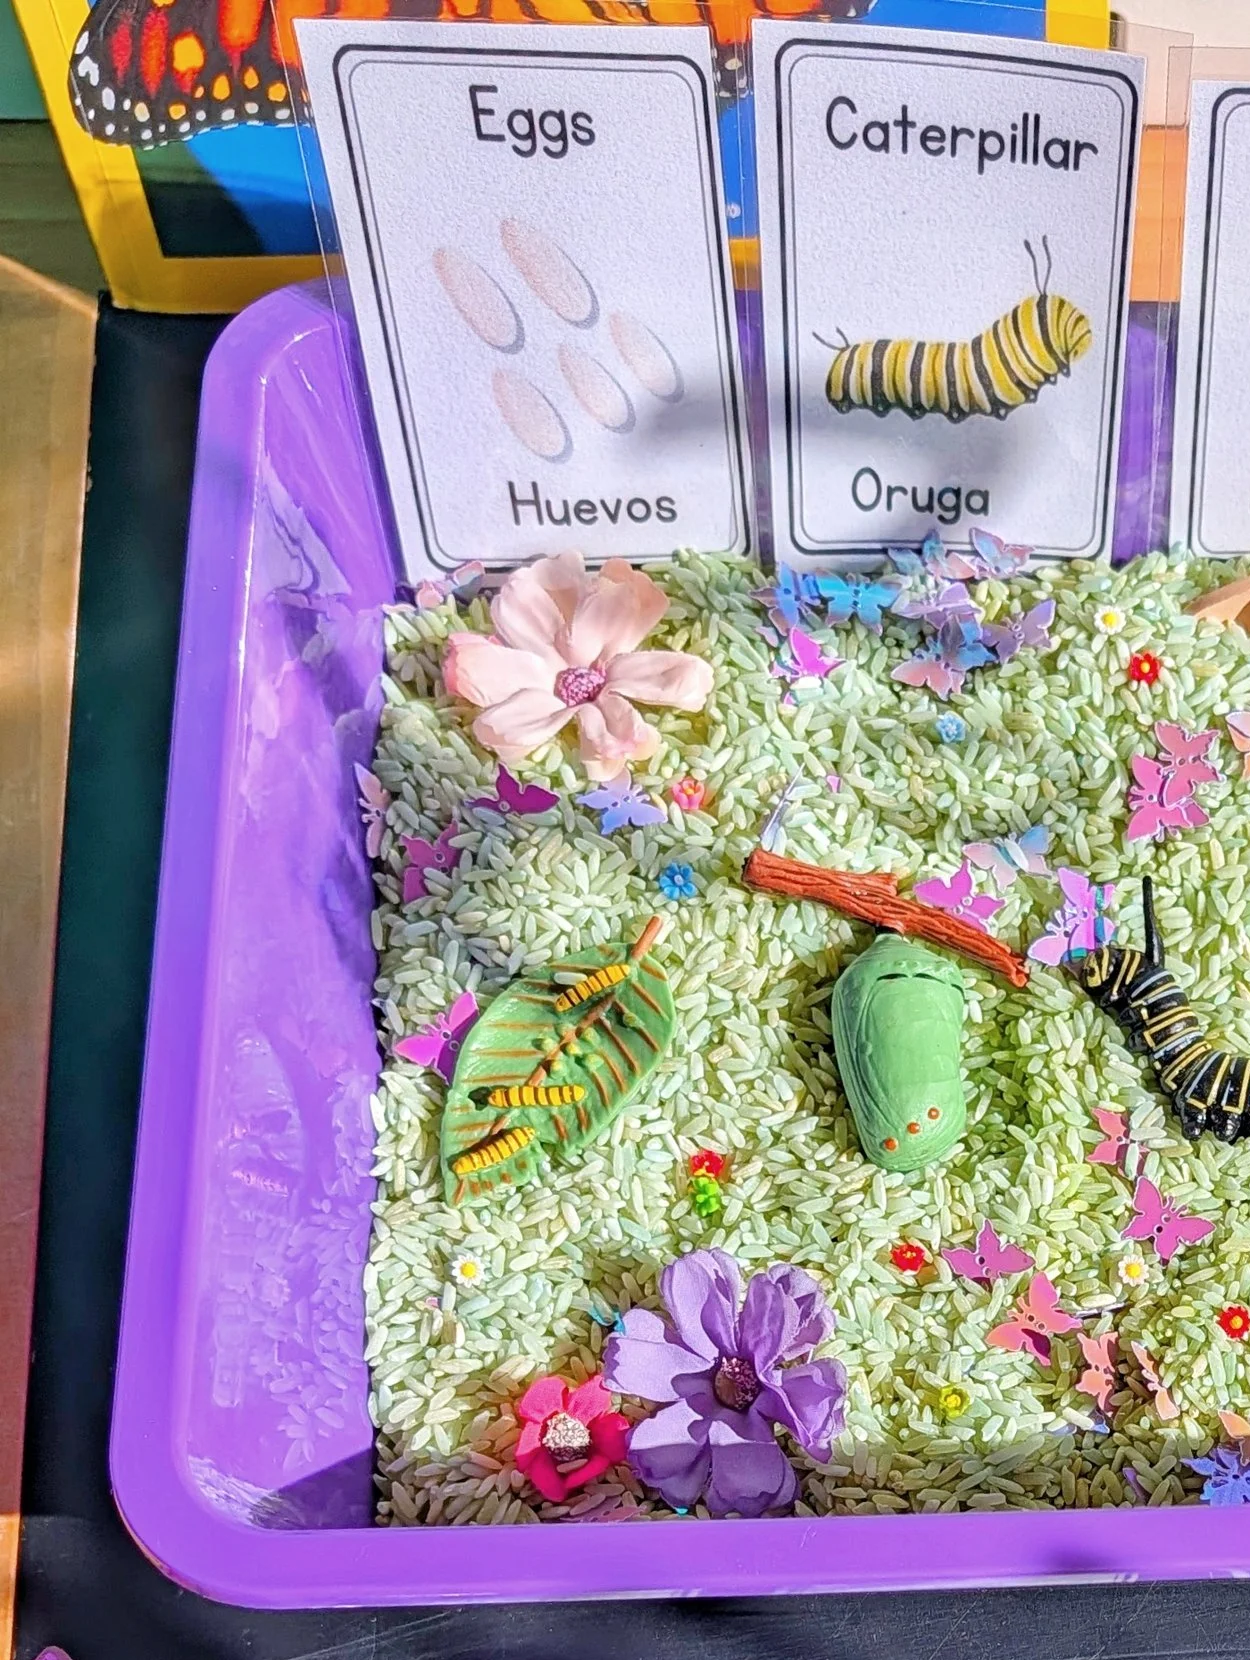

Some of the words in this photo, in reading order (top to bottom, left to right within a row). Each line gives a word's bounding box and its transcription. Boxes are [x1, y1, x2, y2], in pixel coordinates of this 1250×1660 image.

[469, 84, 595, 159] Eggs
[825, 95, 1099, 175] Caterpillar
[508, 481, 678, 528] Huevos
[851, 467, 991, 525] Oruga
